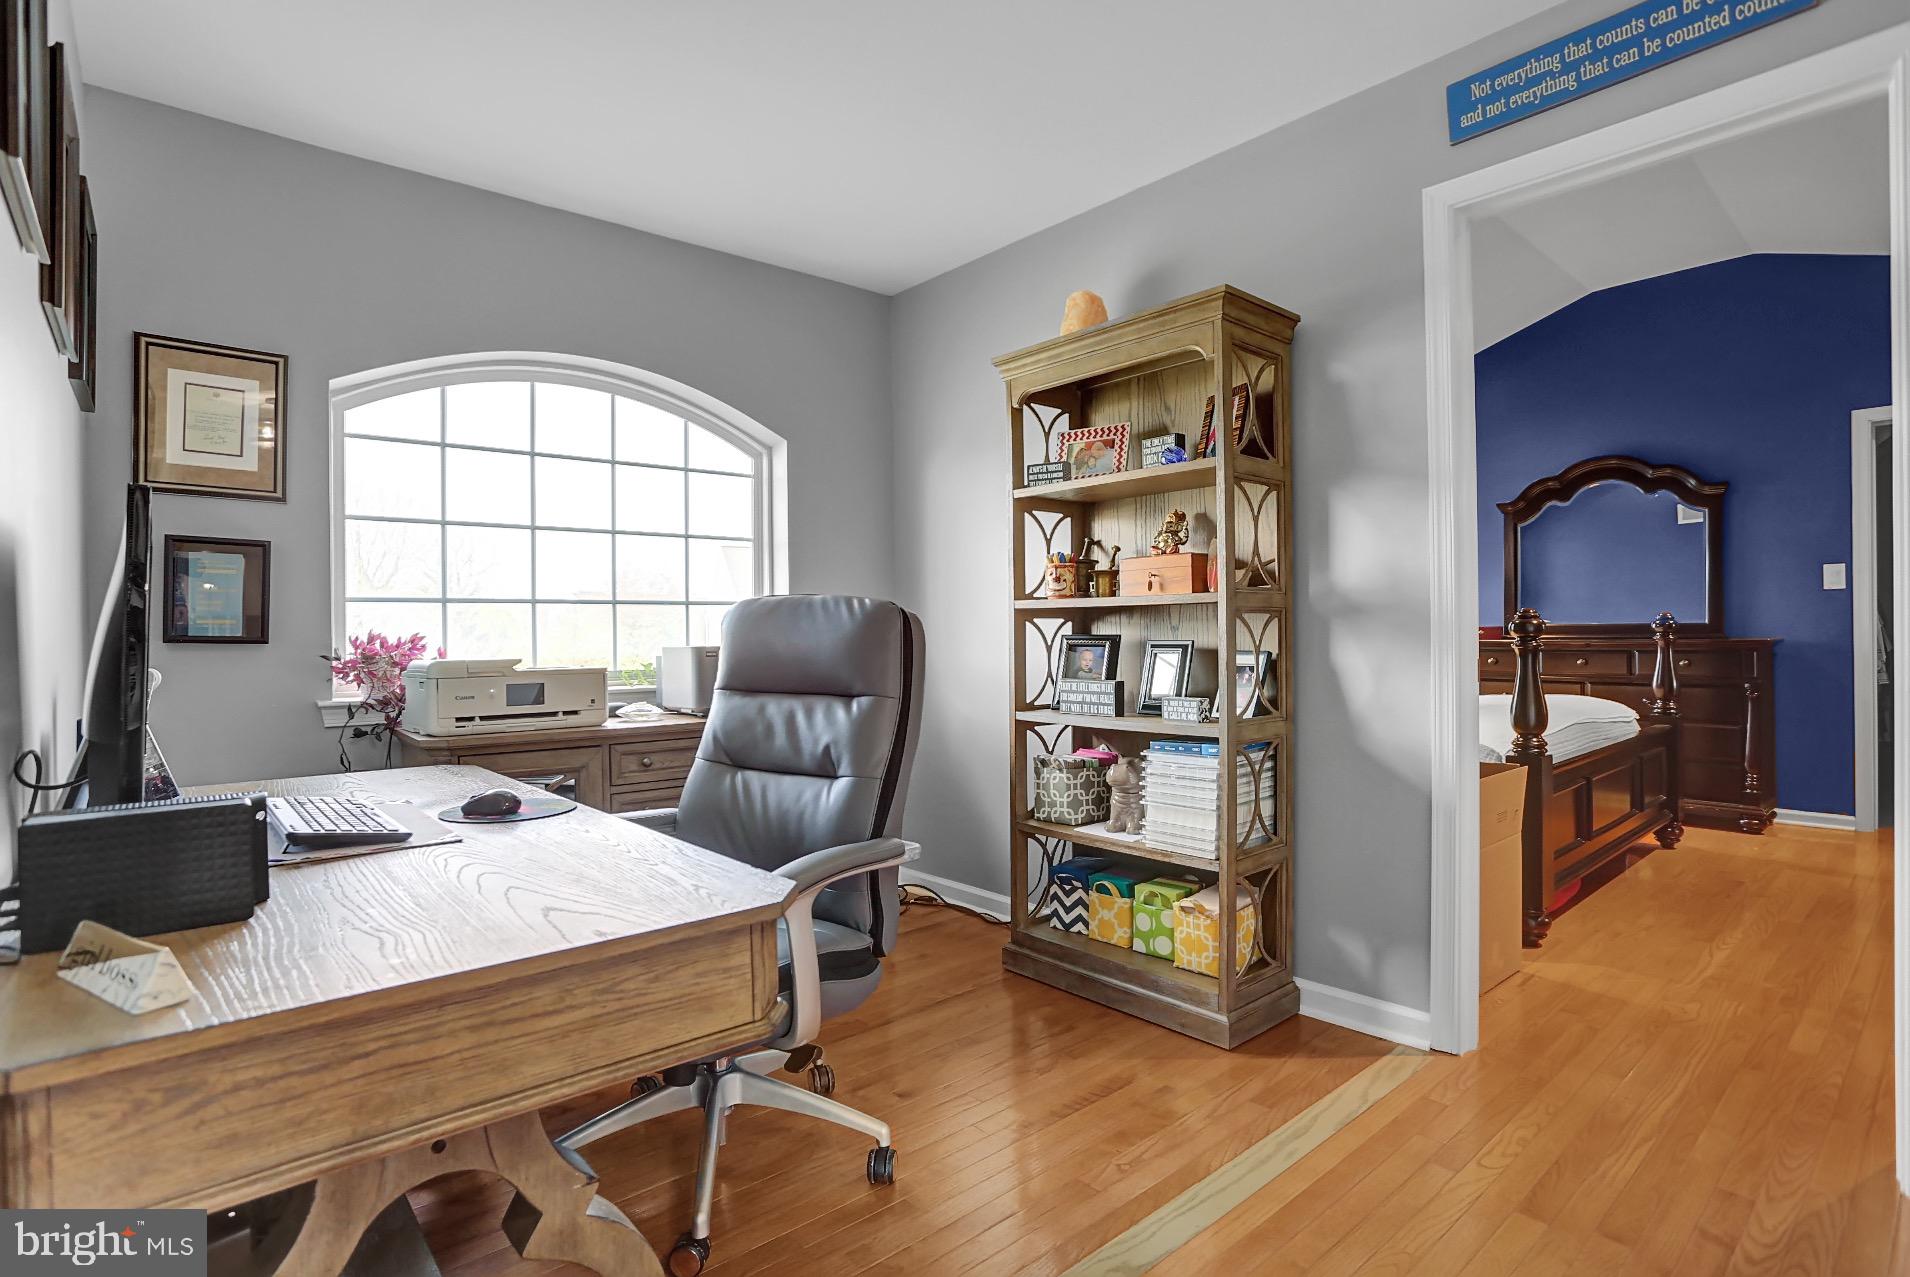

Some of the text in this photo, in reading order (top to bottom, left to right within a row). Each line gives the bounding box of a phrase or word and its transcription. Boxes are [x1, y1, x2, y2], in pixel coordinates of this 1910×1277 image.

[1460, 106, 1483, 128] and
[1486, 99, 1507, 118] not
[1509, 72, 1577, 108] everything
[1580, 55, 1610, 81] that
[1612, 47, 1639, 69] can
[1643, 38, 1662, 57] be
[1666, 6, 1731, 48] counted
[1470, 0, 1701, 100] Not everything that counts can be
